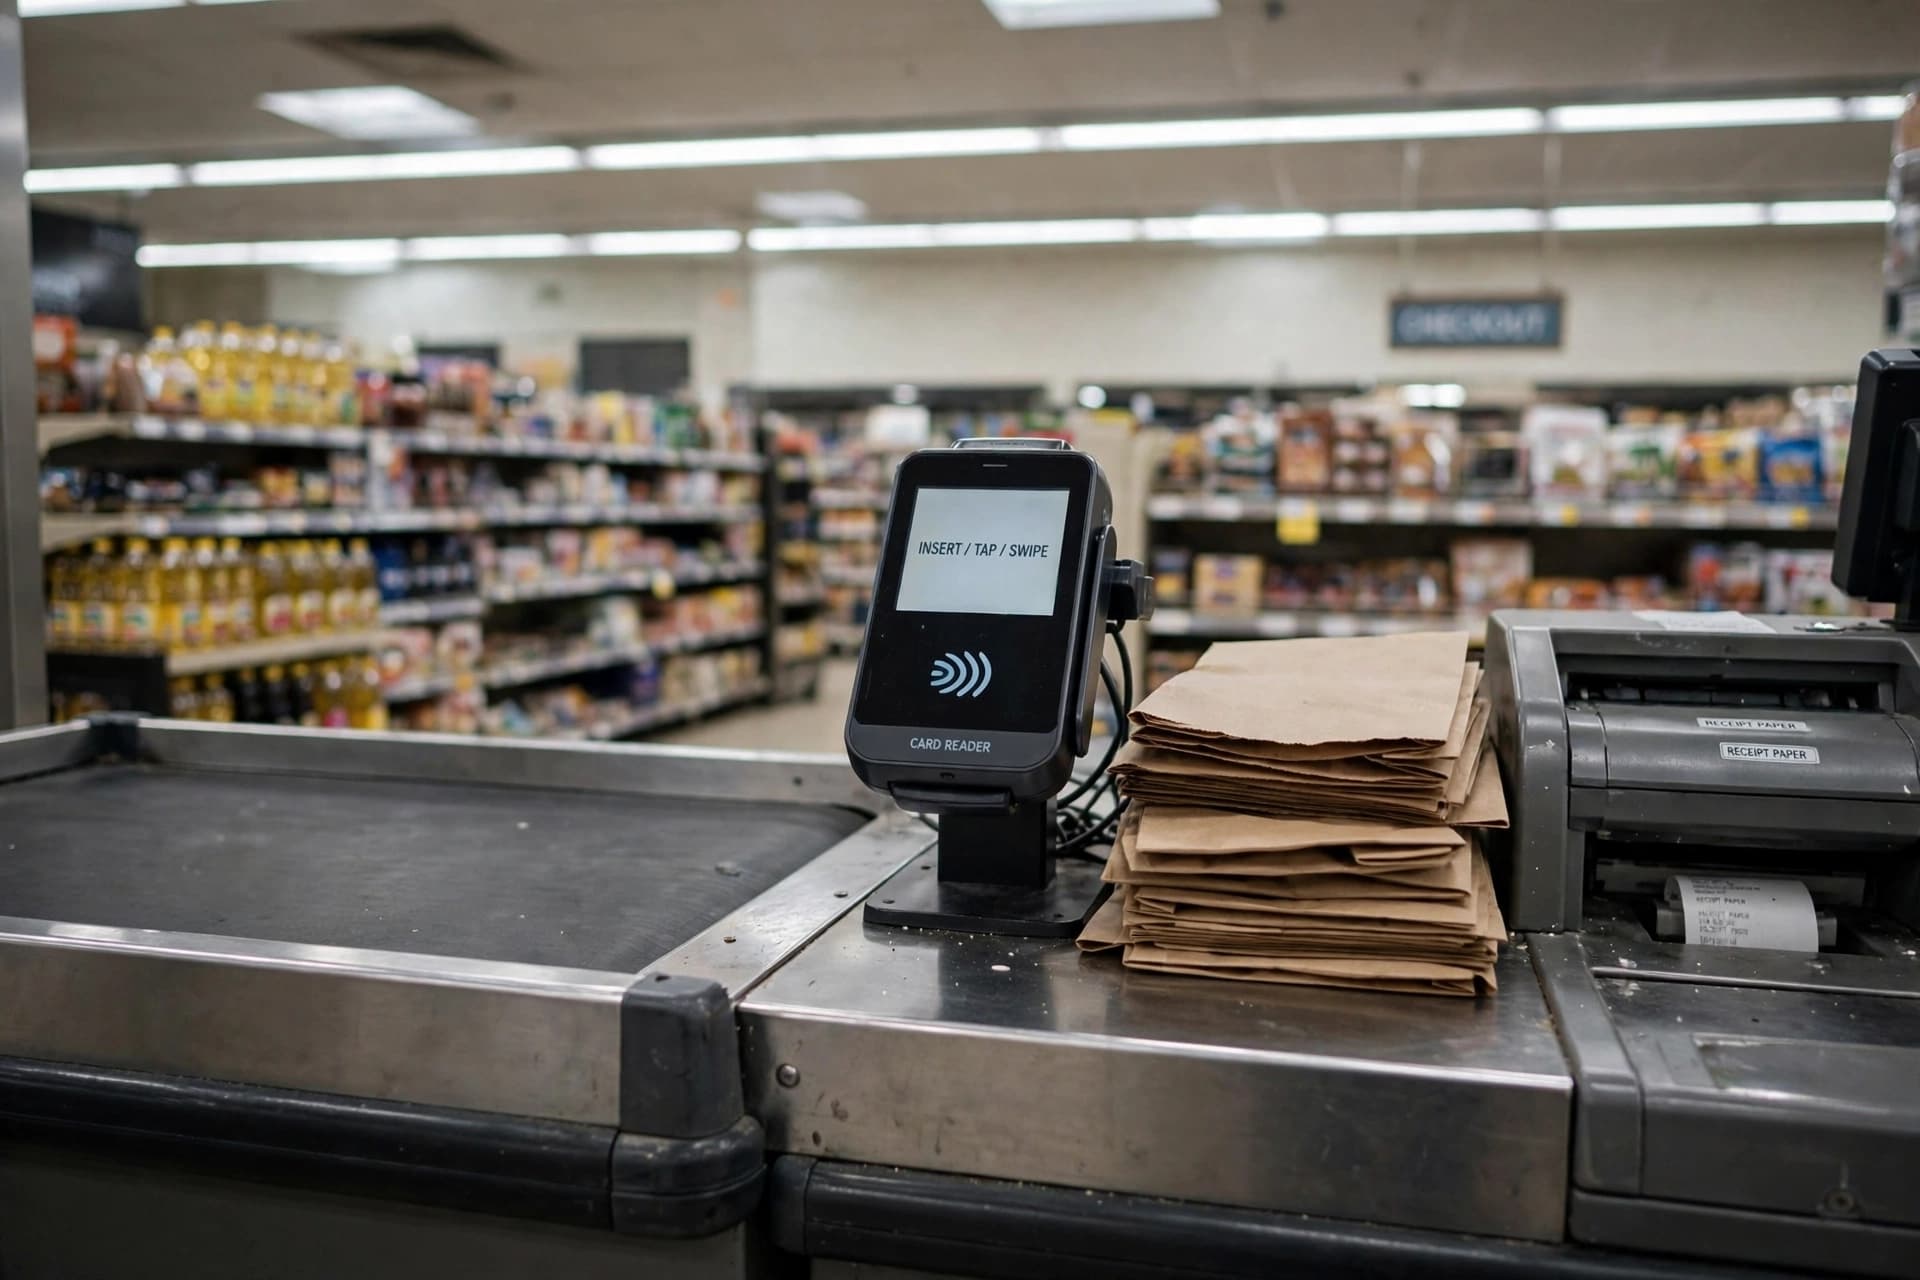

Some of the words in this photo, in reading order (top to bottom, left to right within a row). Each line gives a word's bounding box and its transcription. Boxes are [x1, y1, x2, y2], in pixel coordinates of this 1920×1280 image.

[1398, 308, 1546, 340] CHECKOUT
[918, 541, 963, 555] INSERT
[963, 542, 972, 556] /
[974, 543, 997, 556] TAP
[999, 543, 1007, 557] /
[1009, 544, 1049, 557] SWIPE
[1705, 719, 1752, 728] RECEIPT
[1757, 721, 1797, 729] PAPER
[910, 737, 941, 750] CARD
[944, 739, 991, 753] READER
[1727, 746, 1769, 758] RECEIPT
[1773, 749, 1807, 759] PAPER
